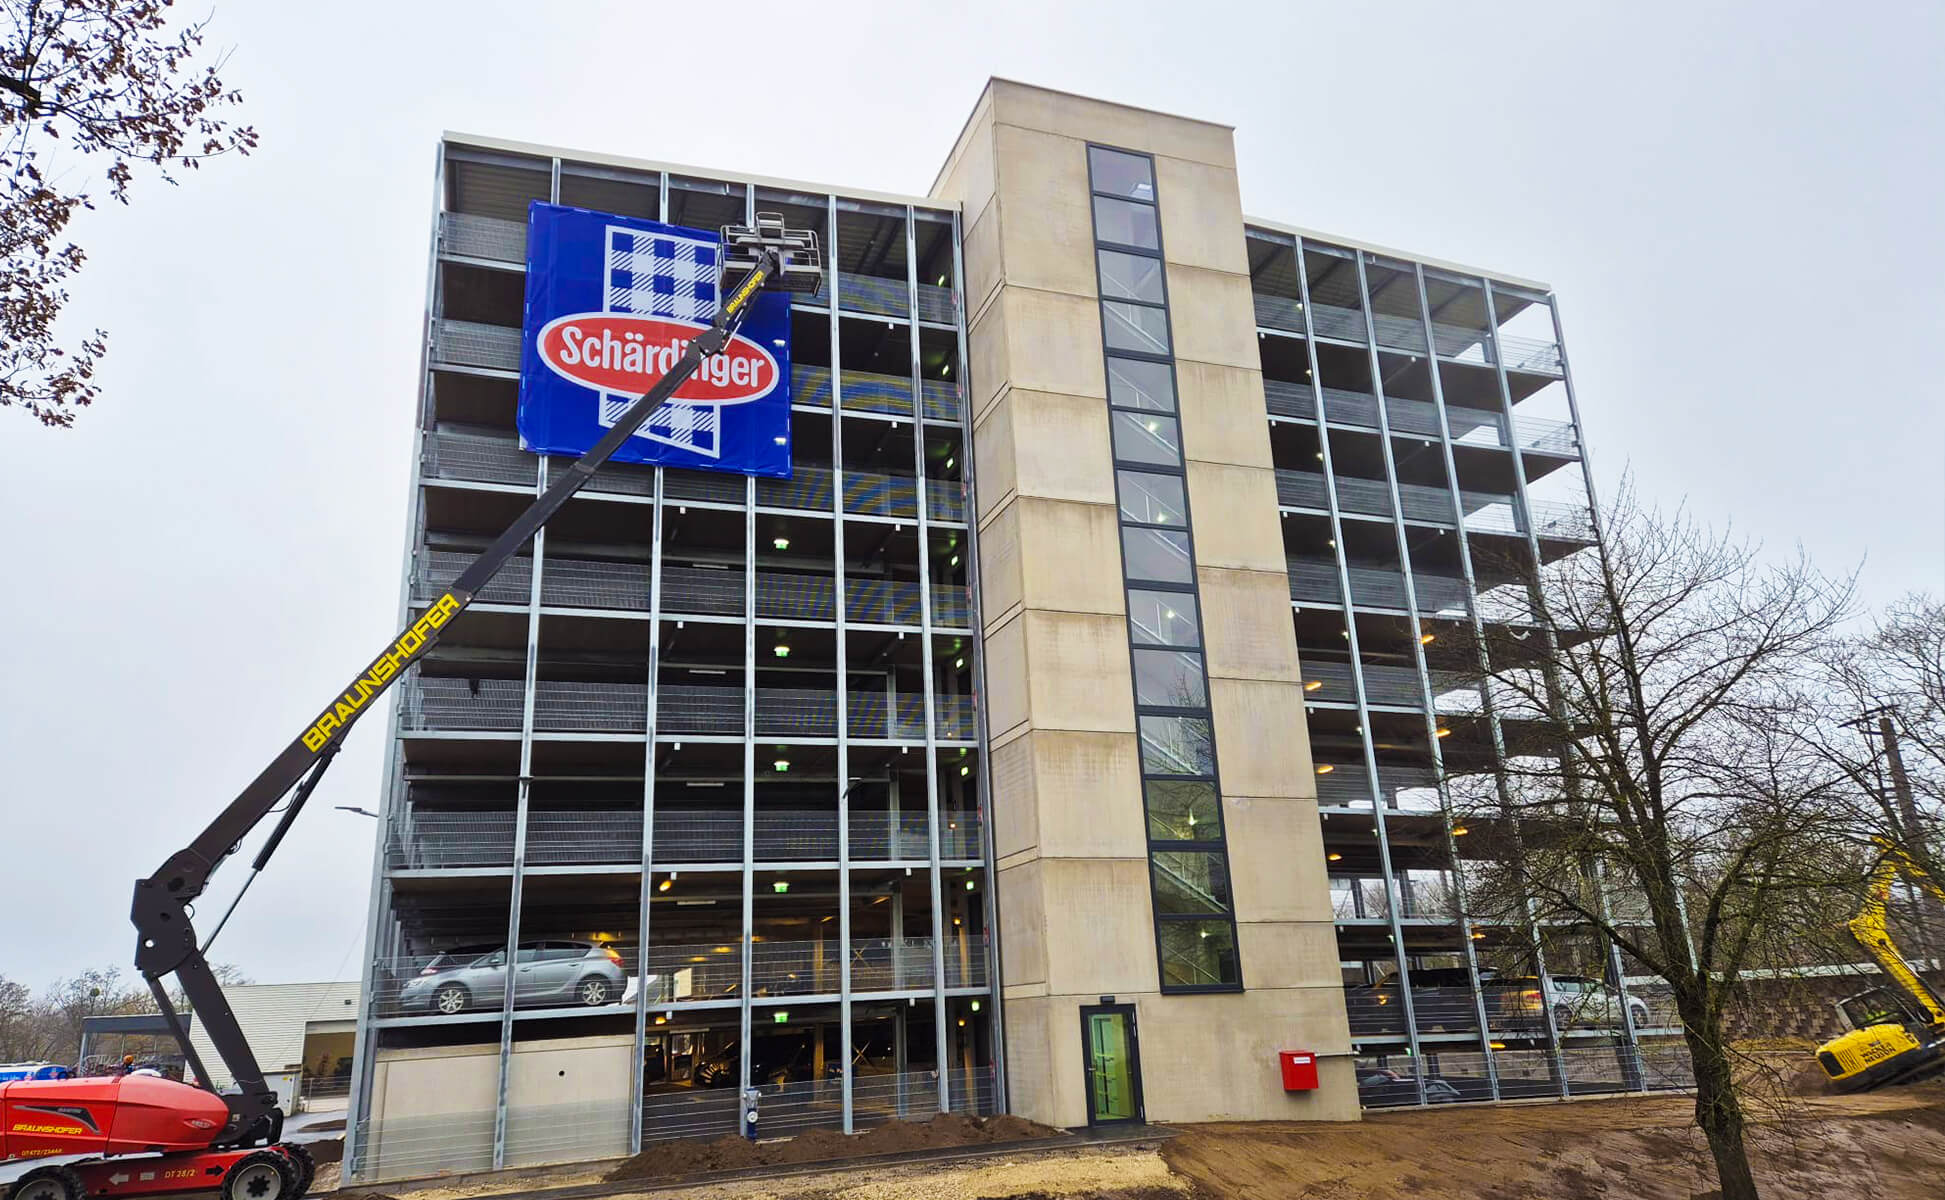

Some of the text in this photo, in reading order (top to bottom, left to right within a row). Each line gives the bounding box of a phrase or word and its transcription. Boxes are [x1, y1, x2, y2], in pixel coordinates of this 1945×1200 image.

[726, 270, 764, 314] BRAUNSHOFER
[302, 593, 460, 752] BRAUNSHOFER
[12, 1123, 83, 1135] BRAUNSHOFER
